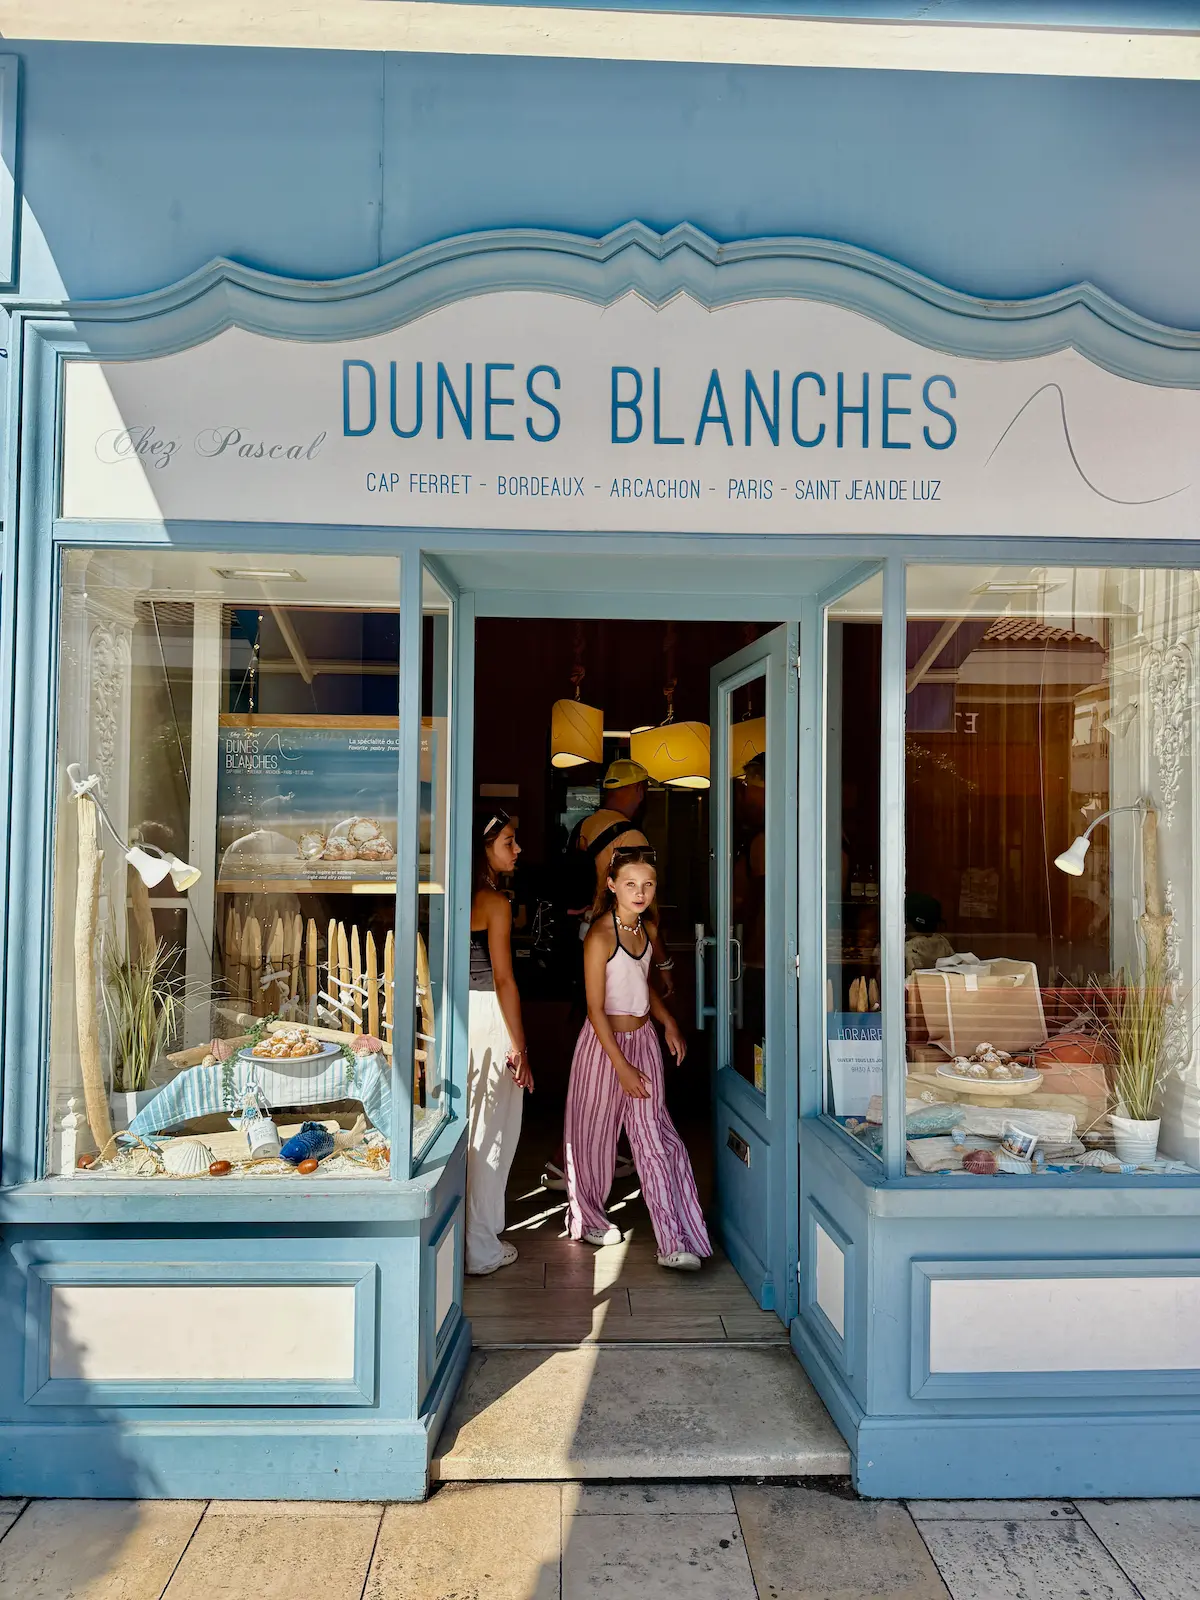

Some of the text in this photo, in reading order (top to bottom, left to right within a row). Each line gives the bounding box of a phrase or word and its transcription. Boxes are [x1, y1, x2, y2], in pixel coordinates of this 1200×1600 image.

[342, 360, 958, 450] DUNES BLANCHES
[95, 425, 327, 469] Chez Pascal
[366, 472, 400, 492] CAP
[409, 473, 472, 494] FERRET
[497, 475, 585, 496] BORDEAUX
[610, 478, 701, 499] ARCACHON
[728, 479, 773, 499] PARIS
[795, 479, 841, 500] SAINT
[912, 480, 942, 501] LUZ
[226, 739, 259, 754] DUNES
[226, 754, 278, 769] BLANCHES
